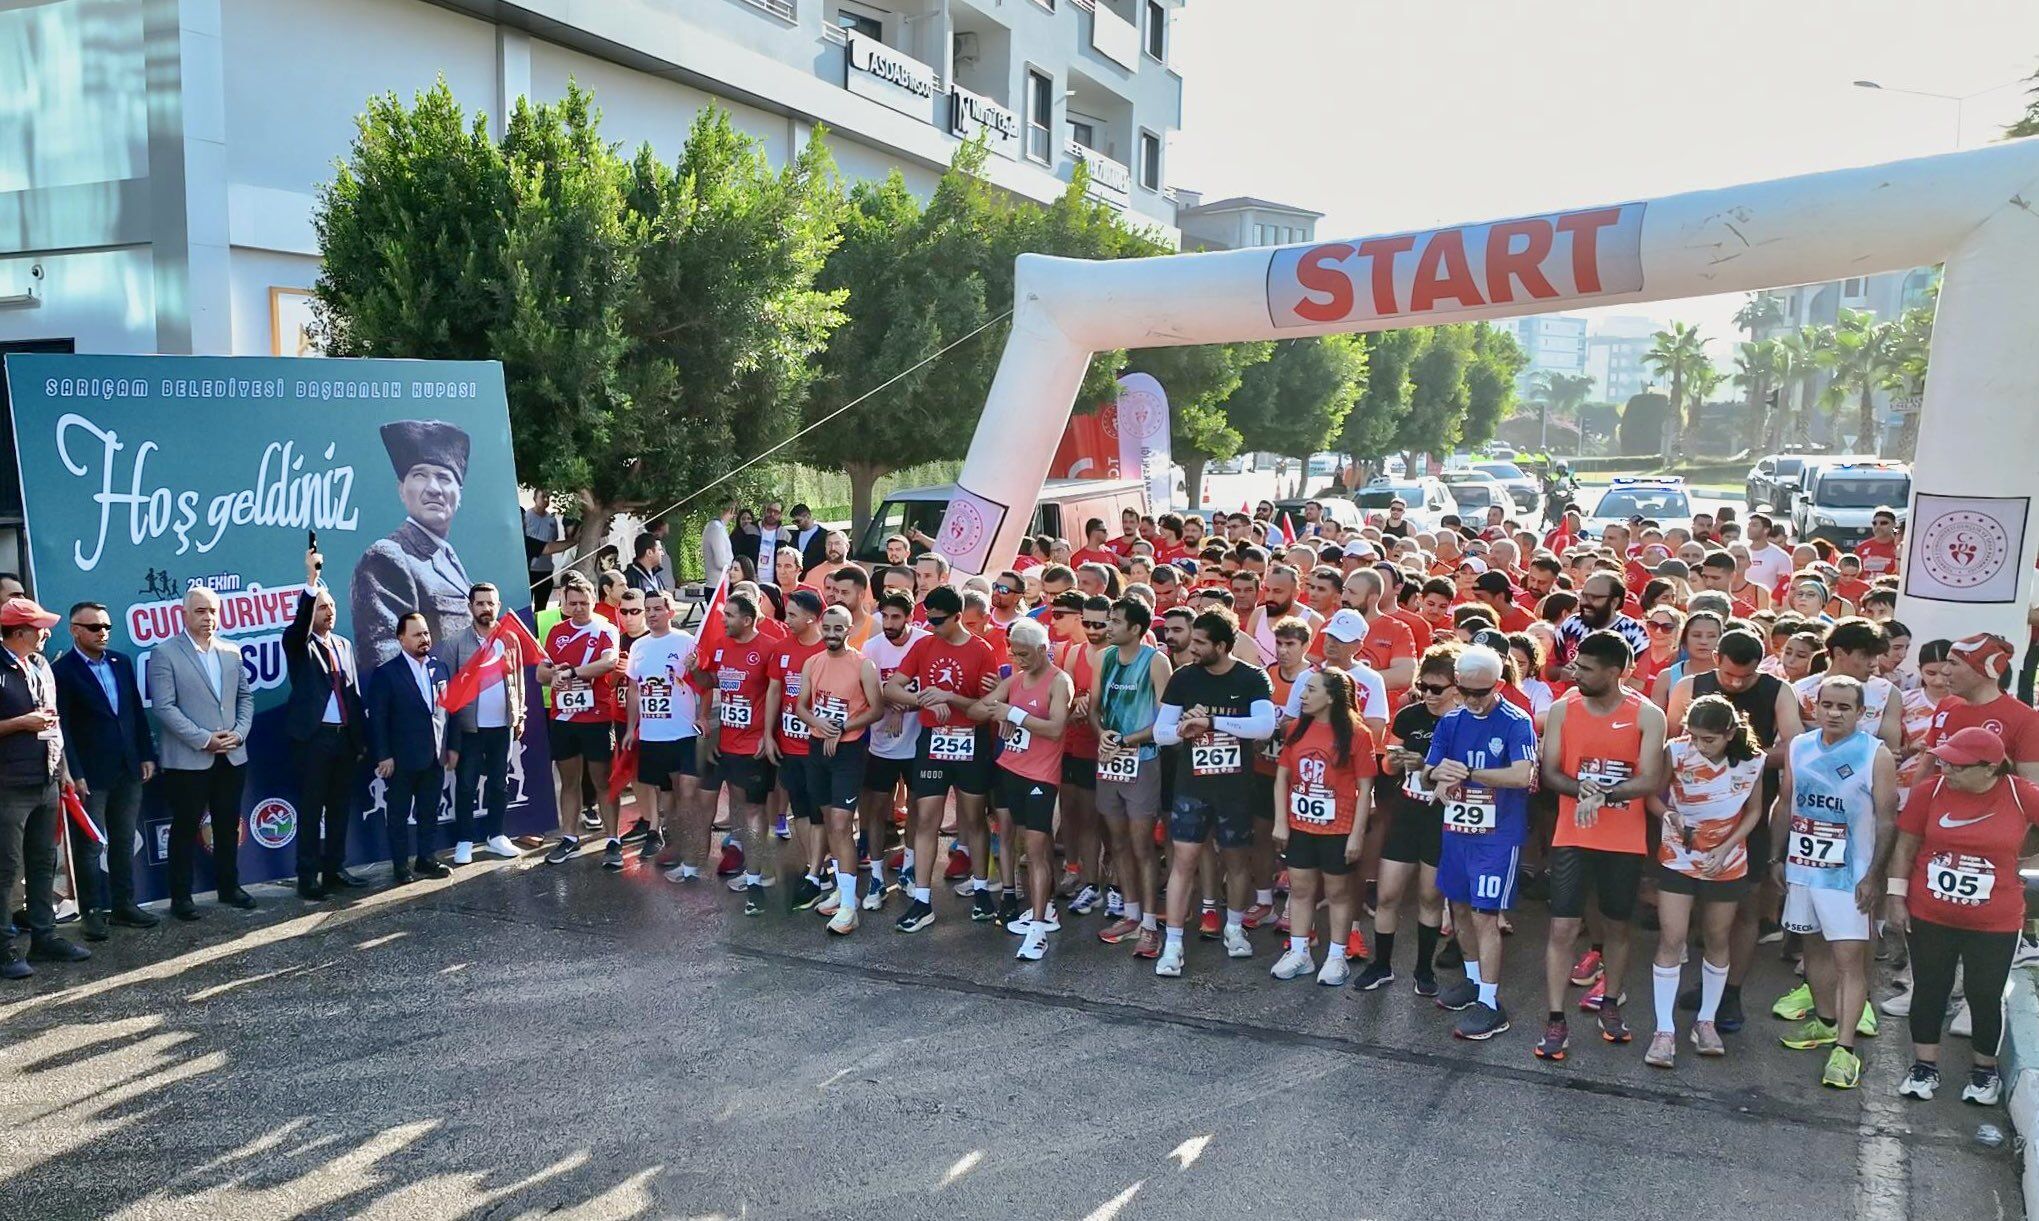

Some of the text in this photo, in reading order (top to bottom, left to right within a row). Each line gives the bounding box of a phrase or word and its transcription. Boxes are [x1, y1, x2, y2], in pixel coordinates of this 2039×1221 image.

[1293, 208, 1622, 322] START
[45, 377, 477, 400] SARIÇAM BELEDİYESİ BAŞKANLIK KUPASI
[56, 411, 360, 572] Hoş geldiniz
[207, 572, 240, 591] EKİM
[563, 692, 587, 707] 64
[641, 698, 670, 712] 182
[722, 706, 749, 722] 153
[932, 737, 973, 753] 254
[1195, 748, 1238, 766] 267
[1466, 750, 1486, 769] 10
[1297, 797, 1325, 817] 06
[1452, 804, 1484, 825] 29
[1800, 836, 1833, 860] 97
[1477, 874, 1500, 898] 10
[1938, 870, 1978, 896] 05
